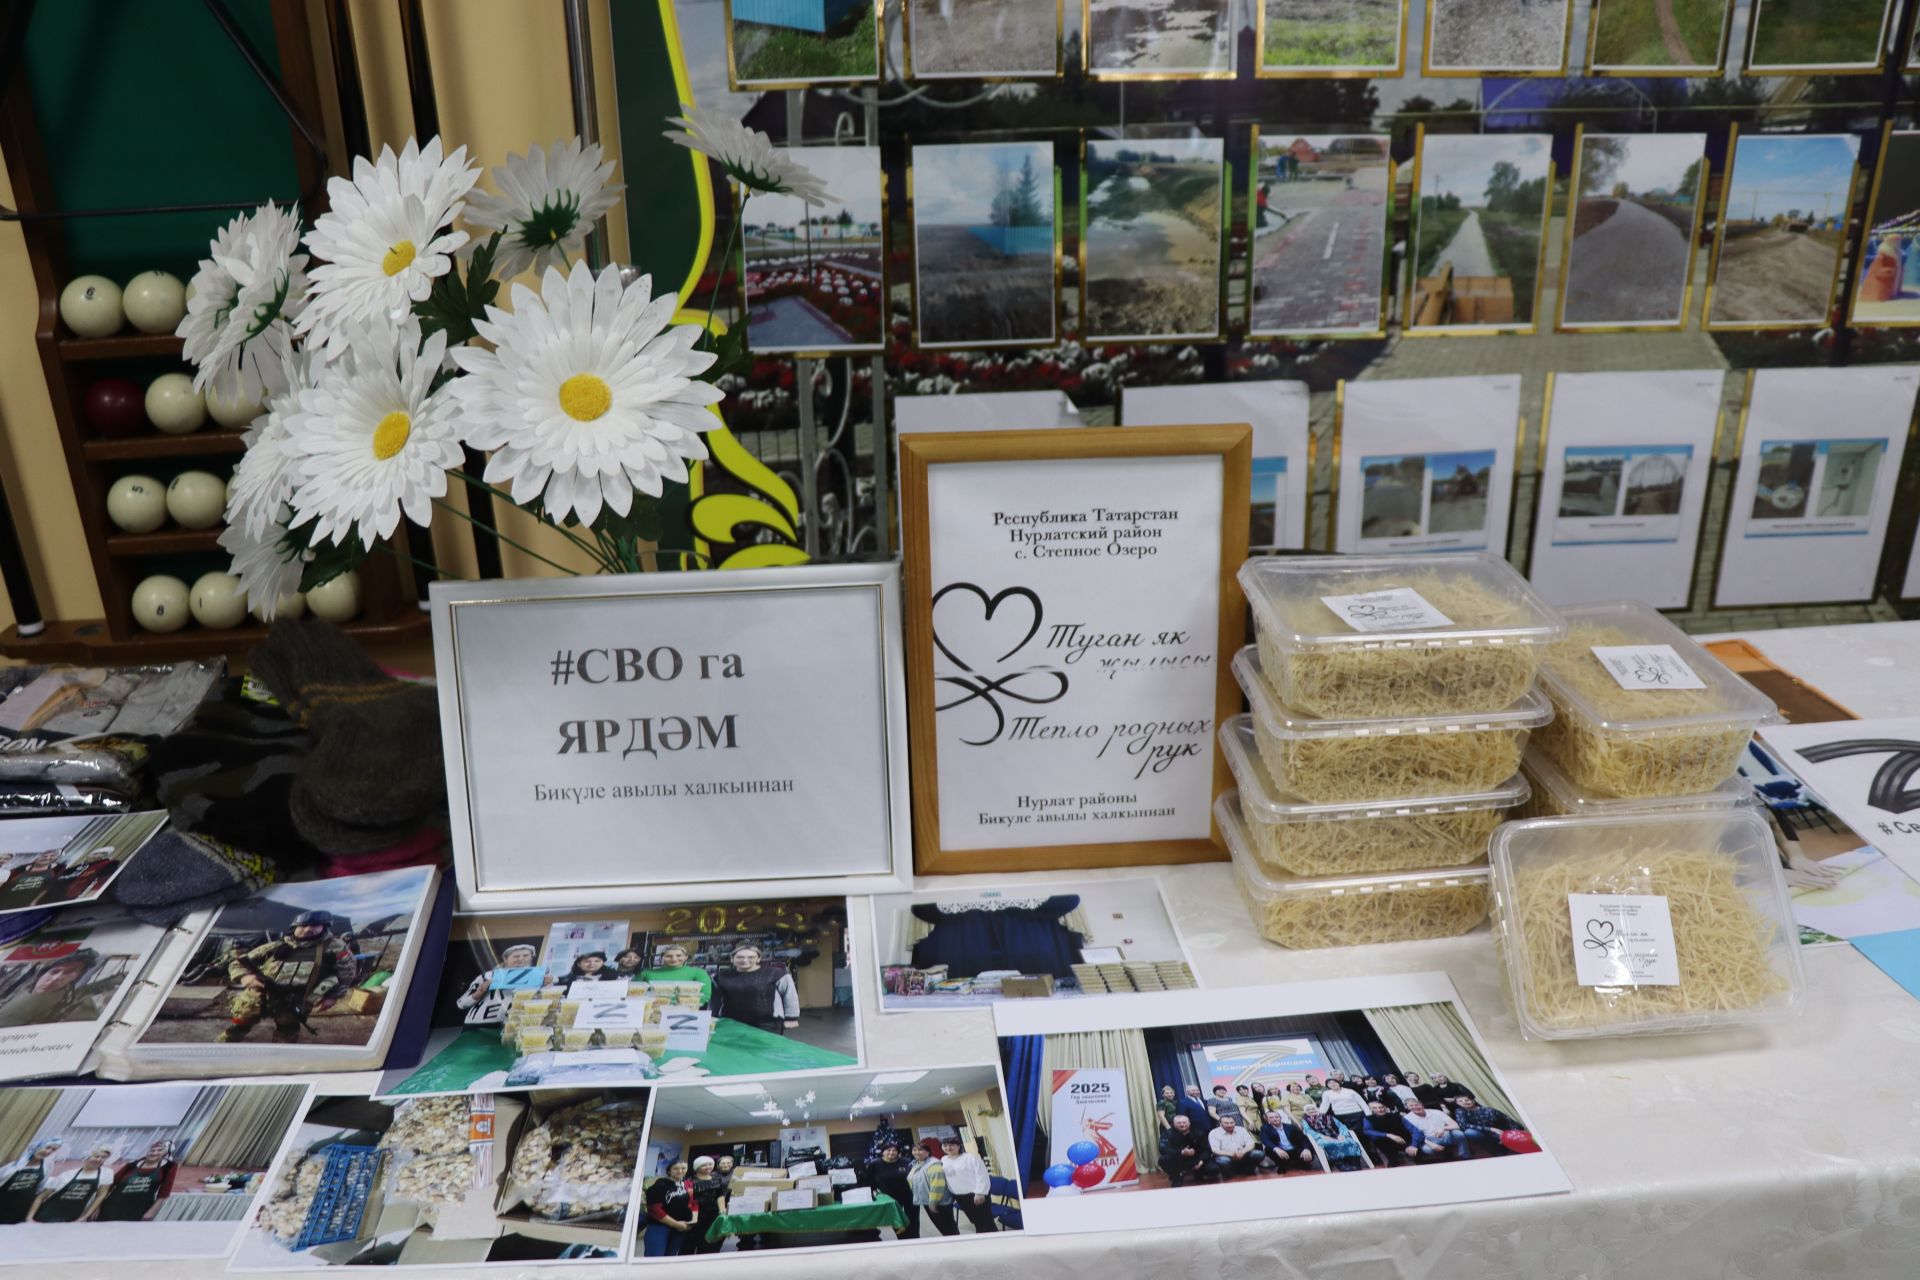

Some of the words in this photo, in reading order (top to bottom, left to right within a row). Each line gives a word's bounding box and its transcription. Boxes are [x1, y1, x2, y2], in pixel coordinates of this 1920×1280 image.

[993, 510, 1087, 527] Республика
[1092, 508, 1179, 523] Татарстан
[1009, 527, 1108, 545] Нурлатский
[1113, 525, 1162, 541] район
[1014, 549, 1027, 560] с.
[1033, 545, 1101, 558] Степное
[1106, 542, 1157, 559] Озеро
[1047, 623, 1144, 665] Туган
[1151, 628, 1191, 645] як
[550, 646, 683, 686] #СВО
[699, 651, 745, 680] га
[556, 714, 740, 760] ЯРДӘМ
[1008, 715, 1099, 741] Тепло
[1097, 717, 1214, 759] родных
[1134, 742, 1202, 780] рук
[534, 783, 606, 805] Бикүле
[612, 781, 677, 799] авылы
[684, 777, 794, 797] халкыннан
[1017, 795, 1075, 811] Нурлат
[1079, 792, 1137, 808] районы
[1036, 810, 1087, 822] авылы
[1092, 806, 1175, 821] халкыннан
[1070, 1082, 1111, 1094] 2025
